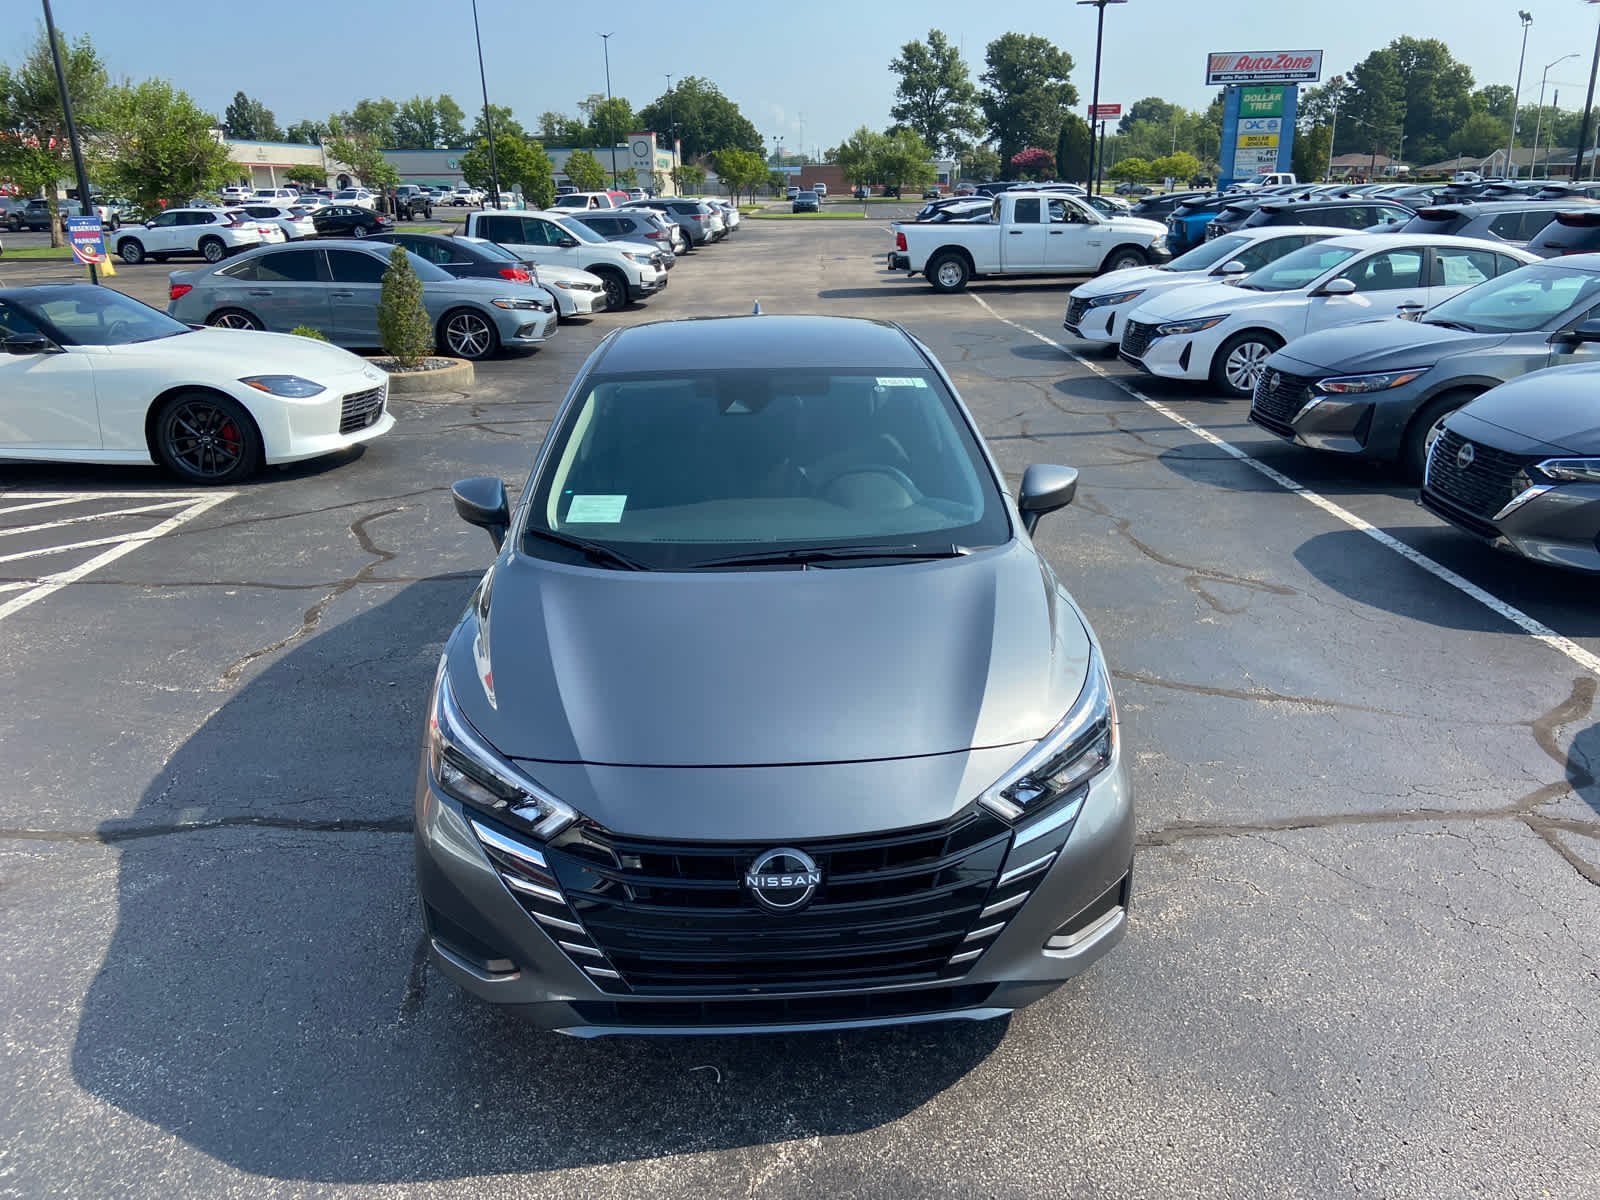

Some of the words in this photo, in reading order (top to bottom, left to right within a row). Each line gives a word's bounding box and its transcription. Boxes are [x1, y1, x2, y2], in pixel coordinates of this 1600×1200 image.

[1234, 54, 1313, 71] AutoZone
[1243, 93, 1282, 103] DOLLAR
[1250, 102, 1273, 110] TREE
[746, 873, 820, 887] NISSAN
